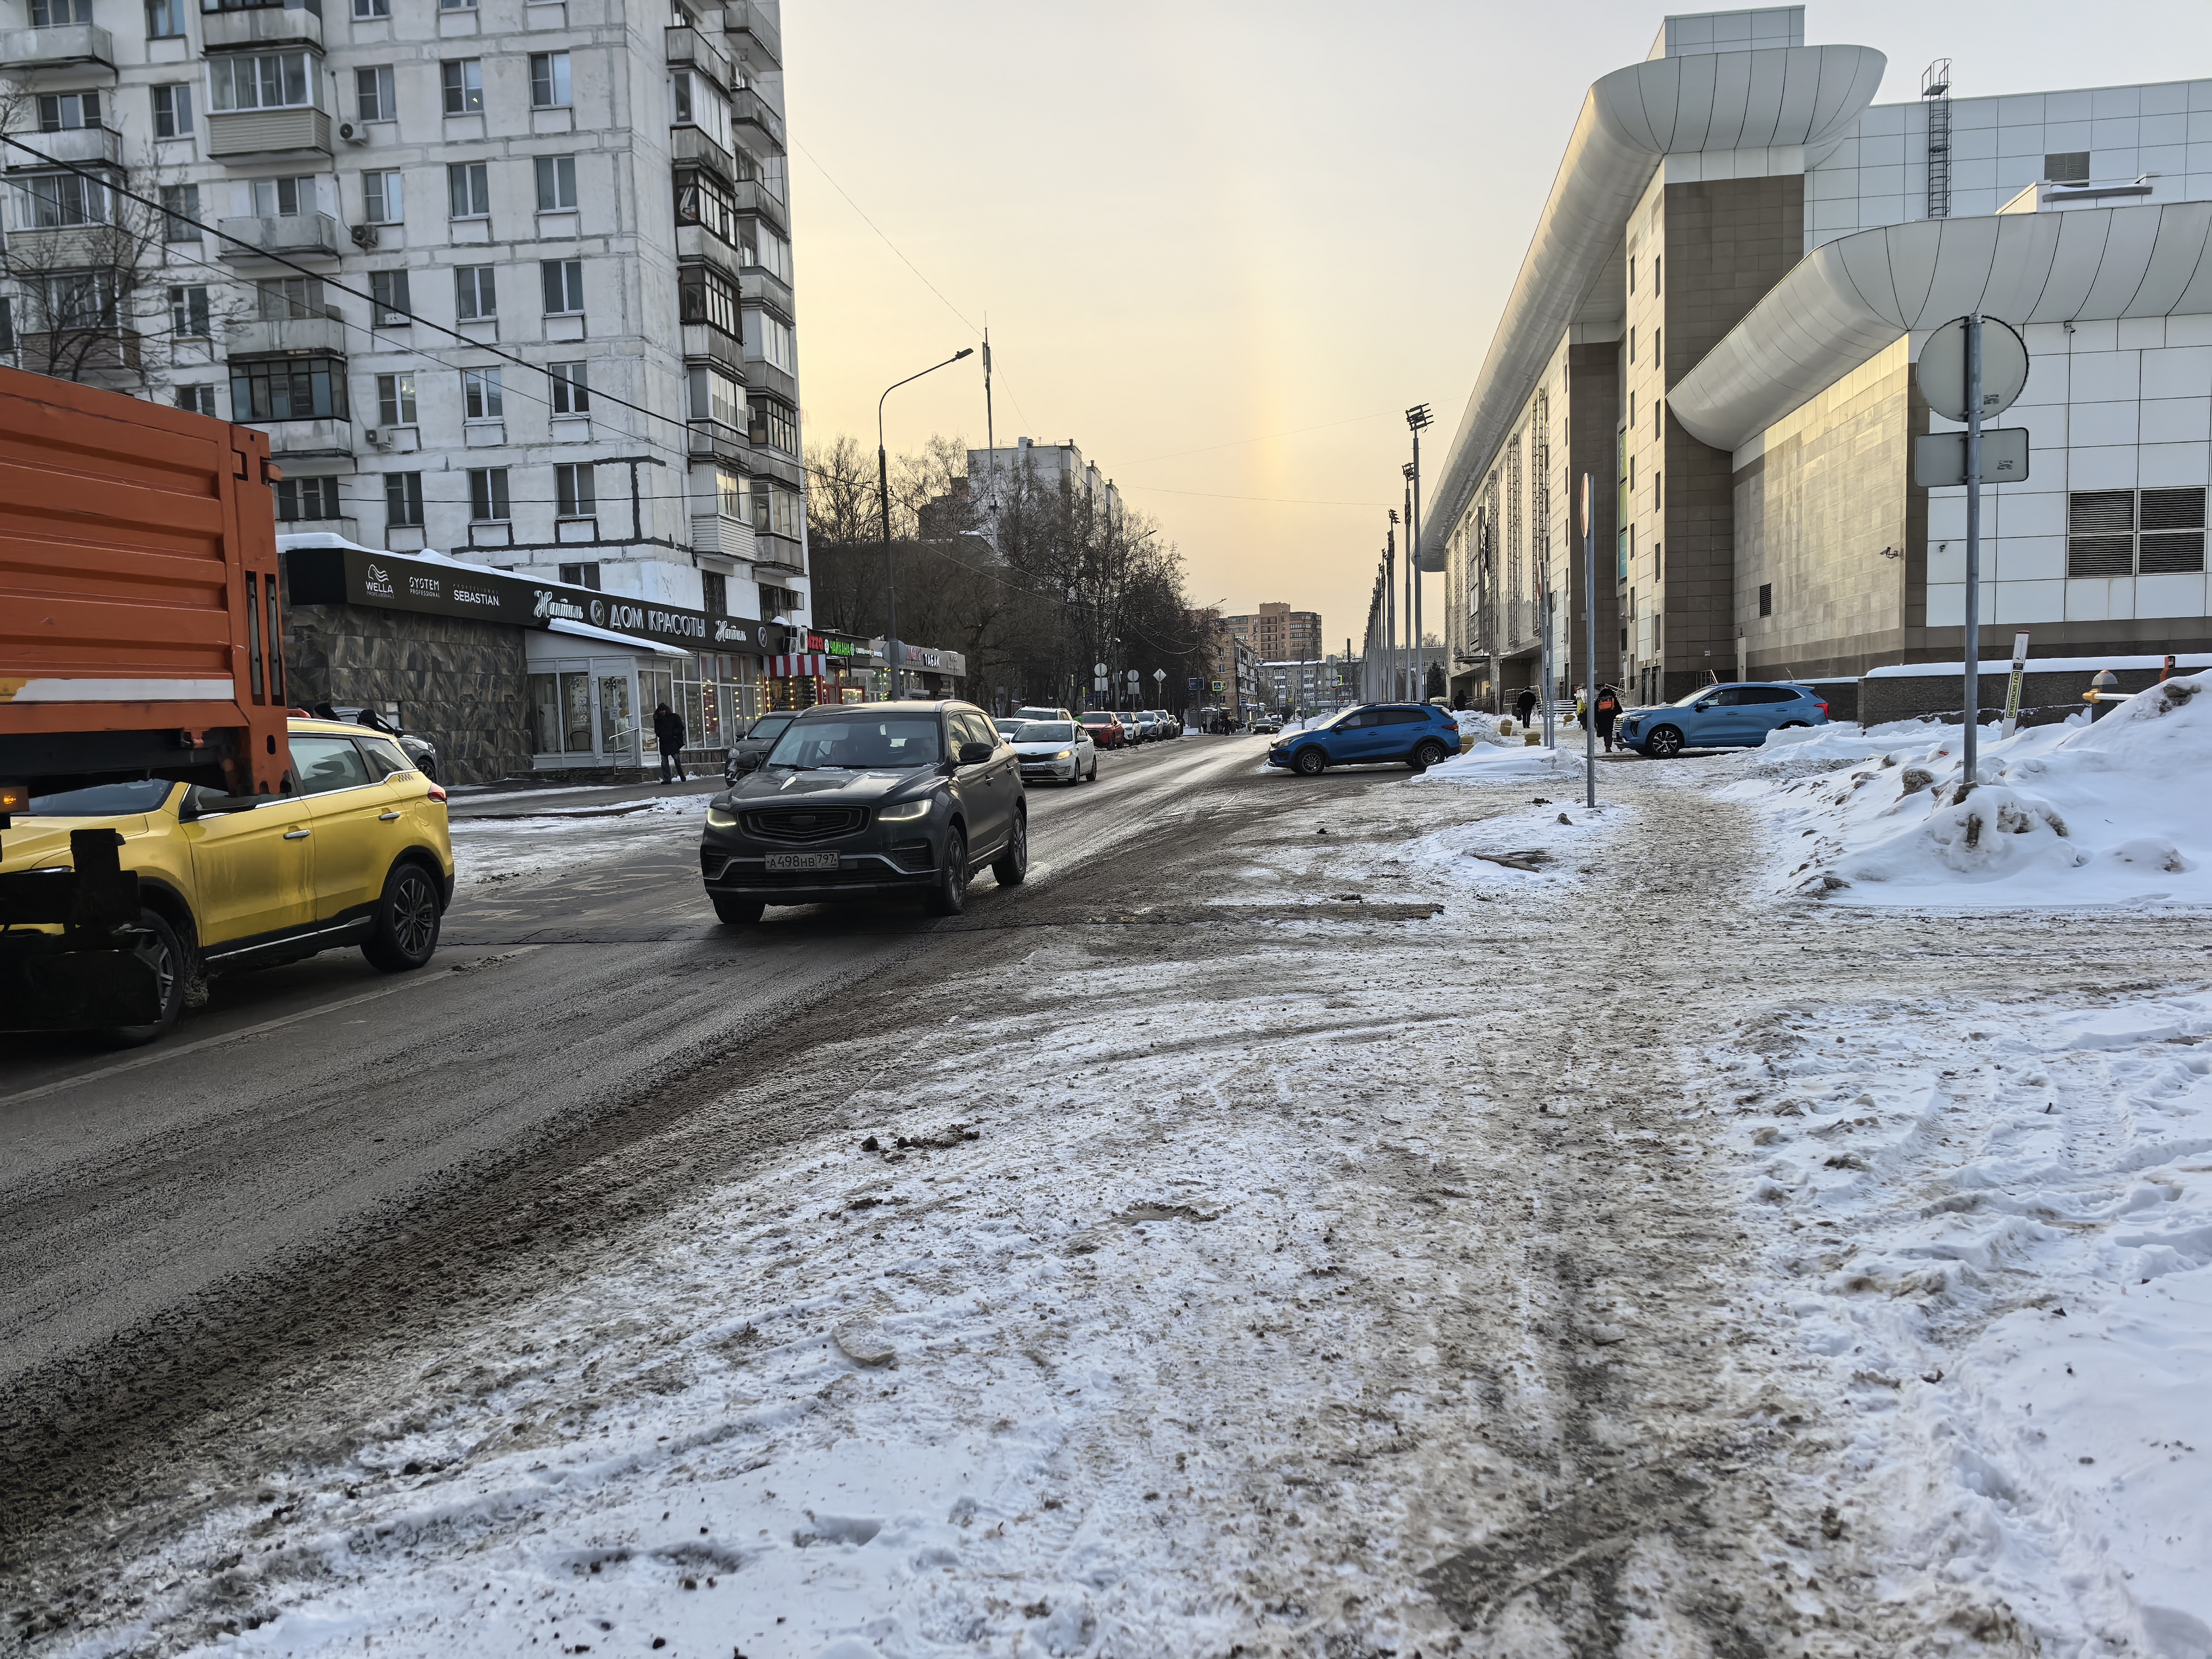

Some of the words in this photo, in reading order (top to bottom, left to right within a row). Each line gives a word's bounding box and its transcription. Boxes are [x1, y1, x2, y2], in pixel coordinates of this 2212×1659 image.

[366, 581, 394, 594] WELLA
[409, 577, 439, 590] SYSTEM
[409, 588, 440, 598] PROFESSIONAL
[454, 589, 500, 606] SEBASTIAN
[610, 604, 644, 630] ДОМ
[648, 610, 705, 638] КРАСОТЫ
[829, 638, 851, 656] ЧАЙХАНА
[925, 653, 940, 667] ТАБАК
[817, 853, 835, 864] 797
